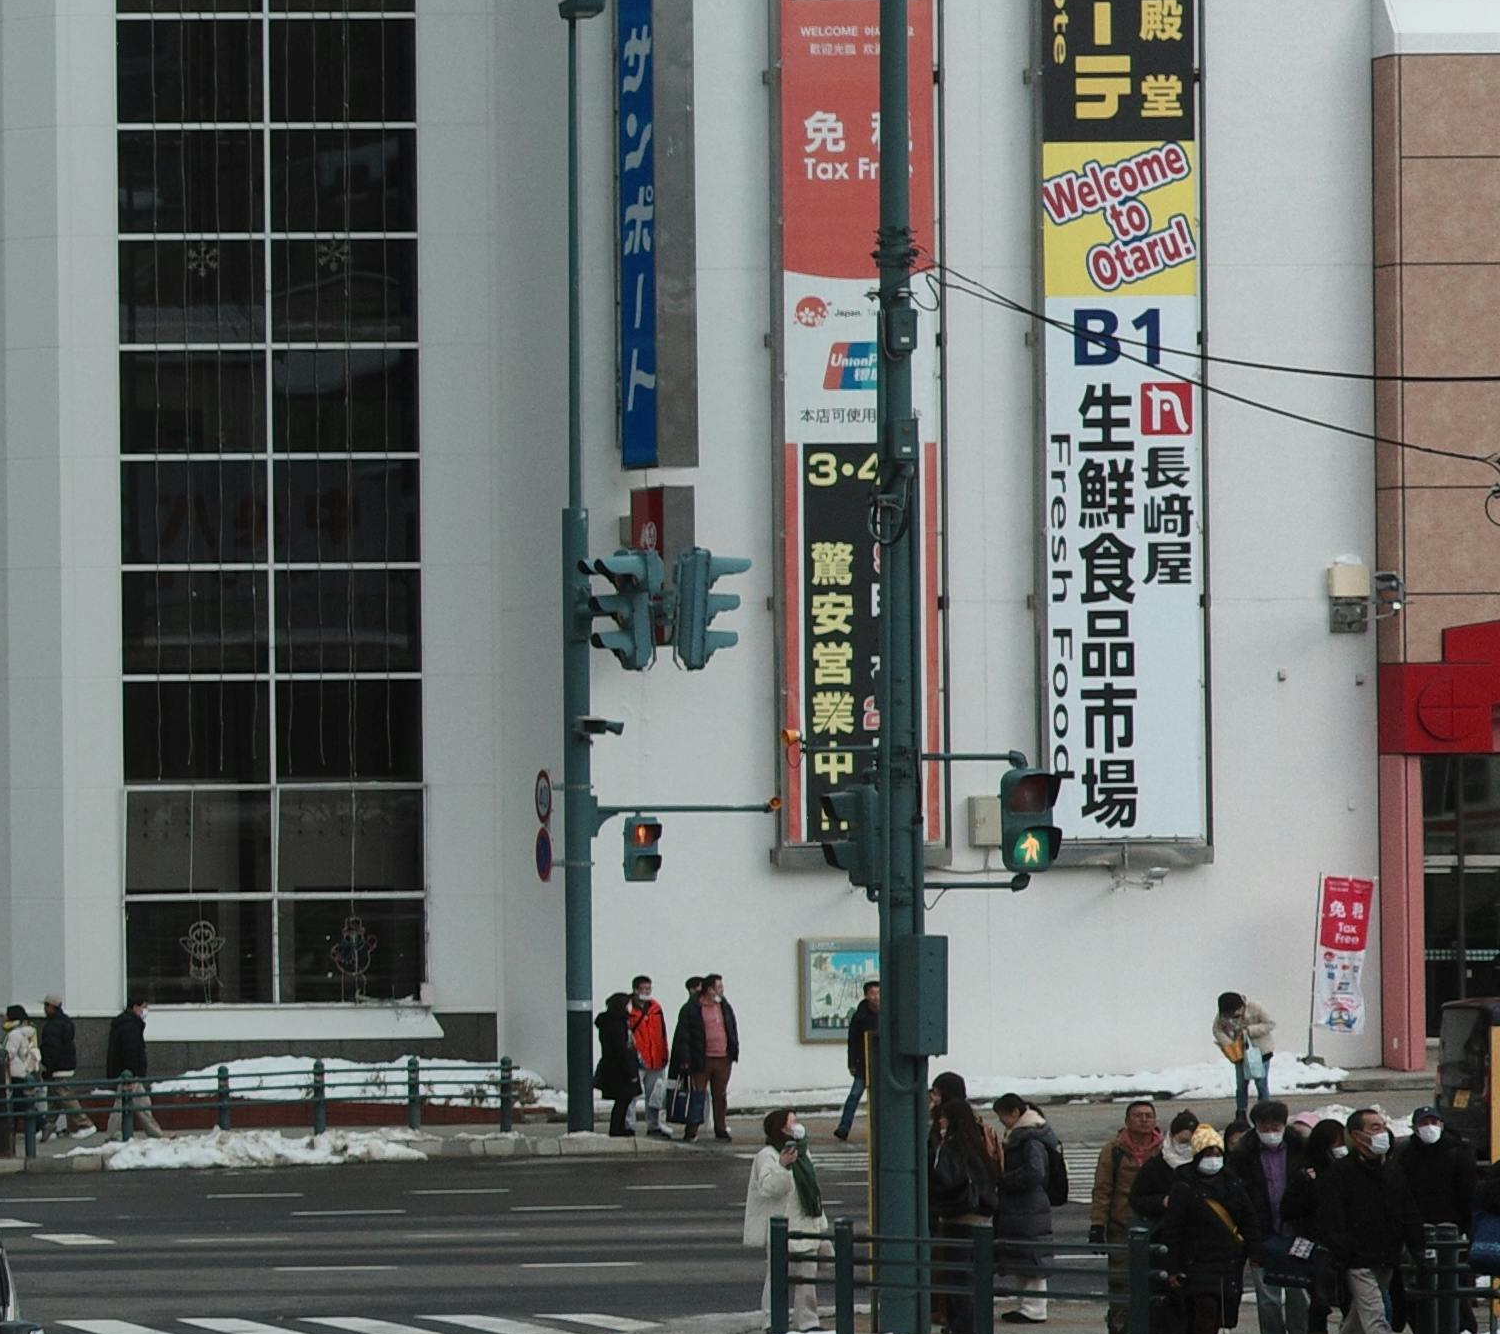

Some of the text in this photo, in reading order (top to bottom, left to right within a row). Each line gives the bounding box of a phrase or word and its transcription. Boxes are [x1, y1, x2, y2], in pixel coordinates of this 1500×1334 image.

[800, 26, 858, 37] WELCOME
[804, 157, 850, 180] Tax
[1043, 144, 1185, 221] Welcome
[622, 22, 657, 413] サンポート
[1110, 203, 1146, 238] to
[1091, 219, 1193, 286] Otaru!
[1073, 308, 1161, 366] B1
[1050, 434, 1075, 780] Fresh Food
[1078, 384, 1138, 829] 生鮮食品市場
[1334, 932, 1360, 945] Free
[1337, 922, 1358, 935] Tax
